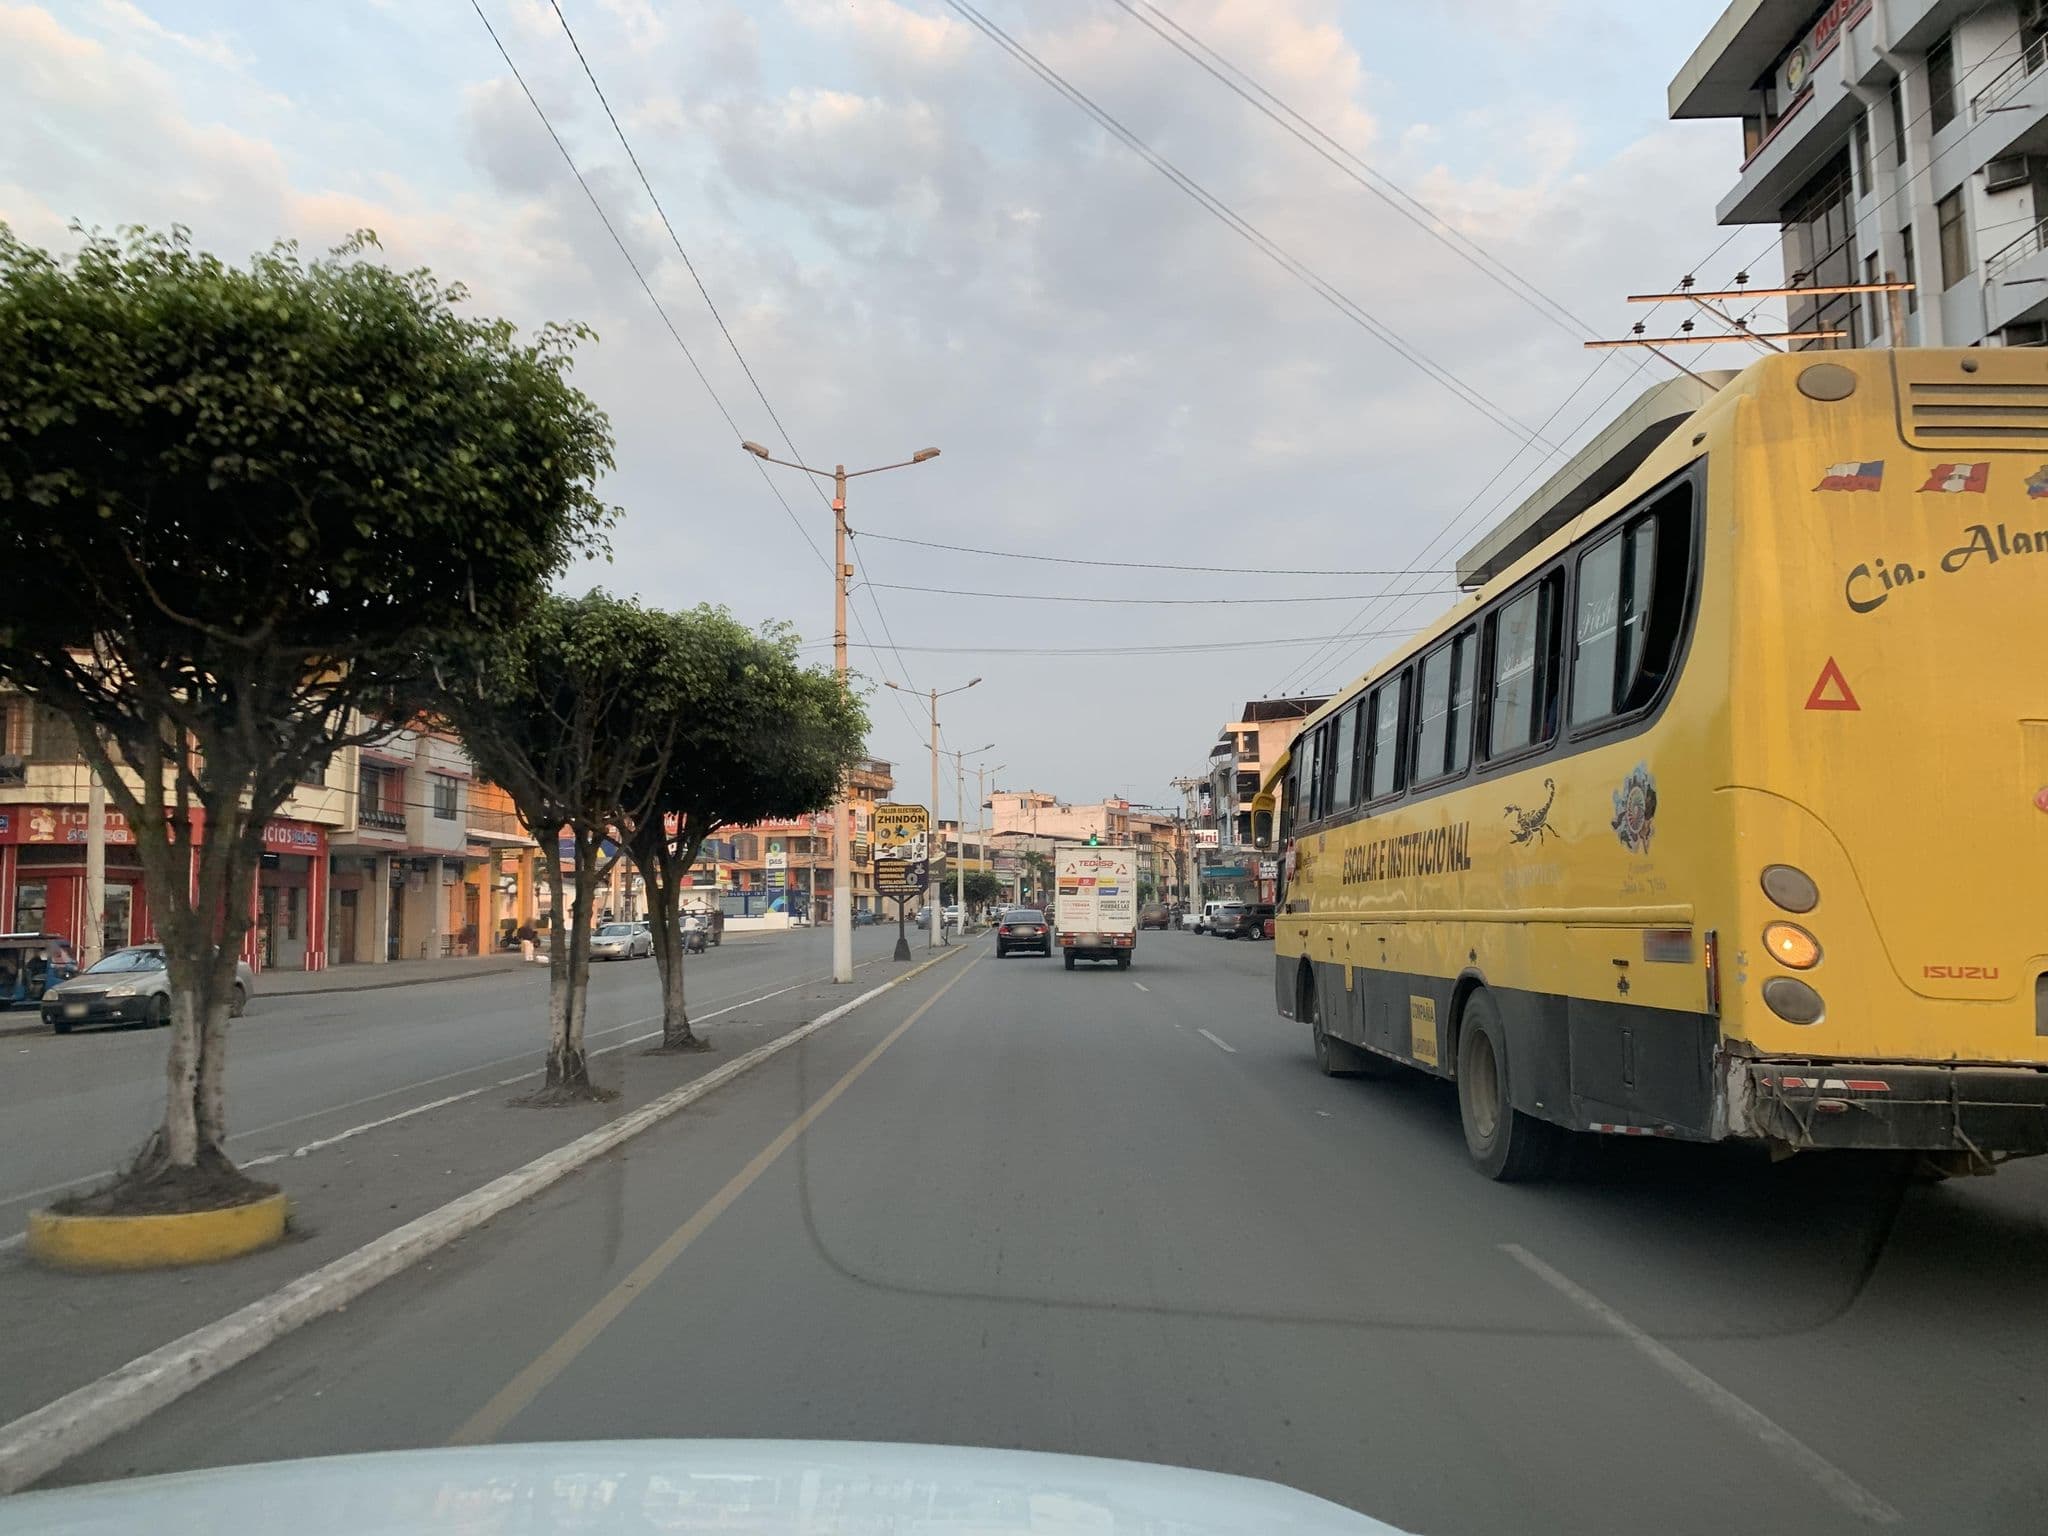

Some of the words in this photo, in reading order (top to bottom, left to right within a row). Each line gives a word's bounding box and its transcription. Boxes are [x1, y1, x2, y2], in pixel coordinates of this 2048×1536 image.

[1846, 558, 1926, 614] Cia.
[1343, 842, 1377, 885] ESCOLAR
[1378, 840, 1386, 880] E
[1387, 821, 1472, 879] INSTITUCIONAL
[1923, 965, 1999, 980] ISUZU
